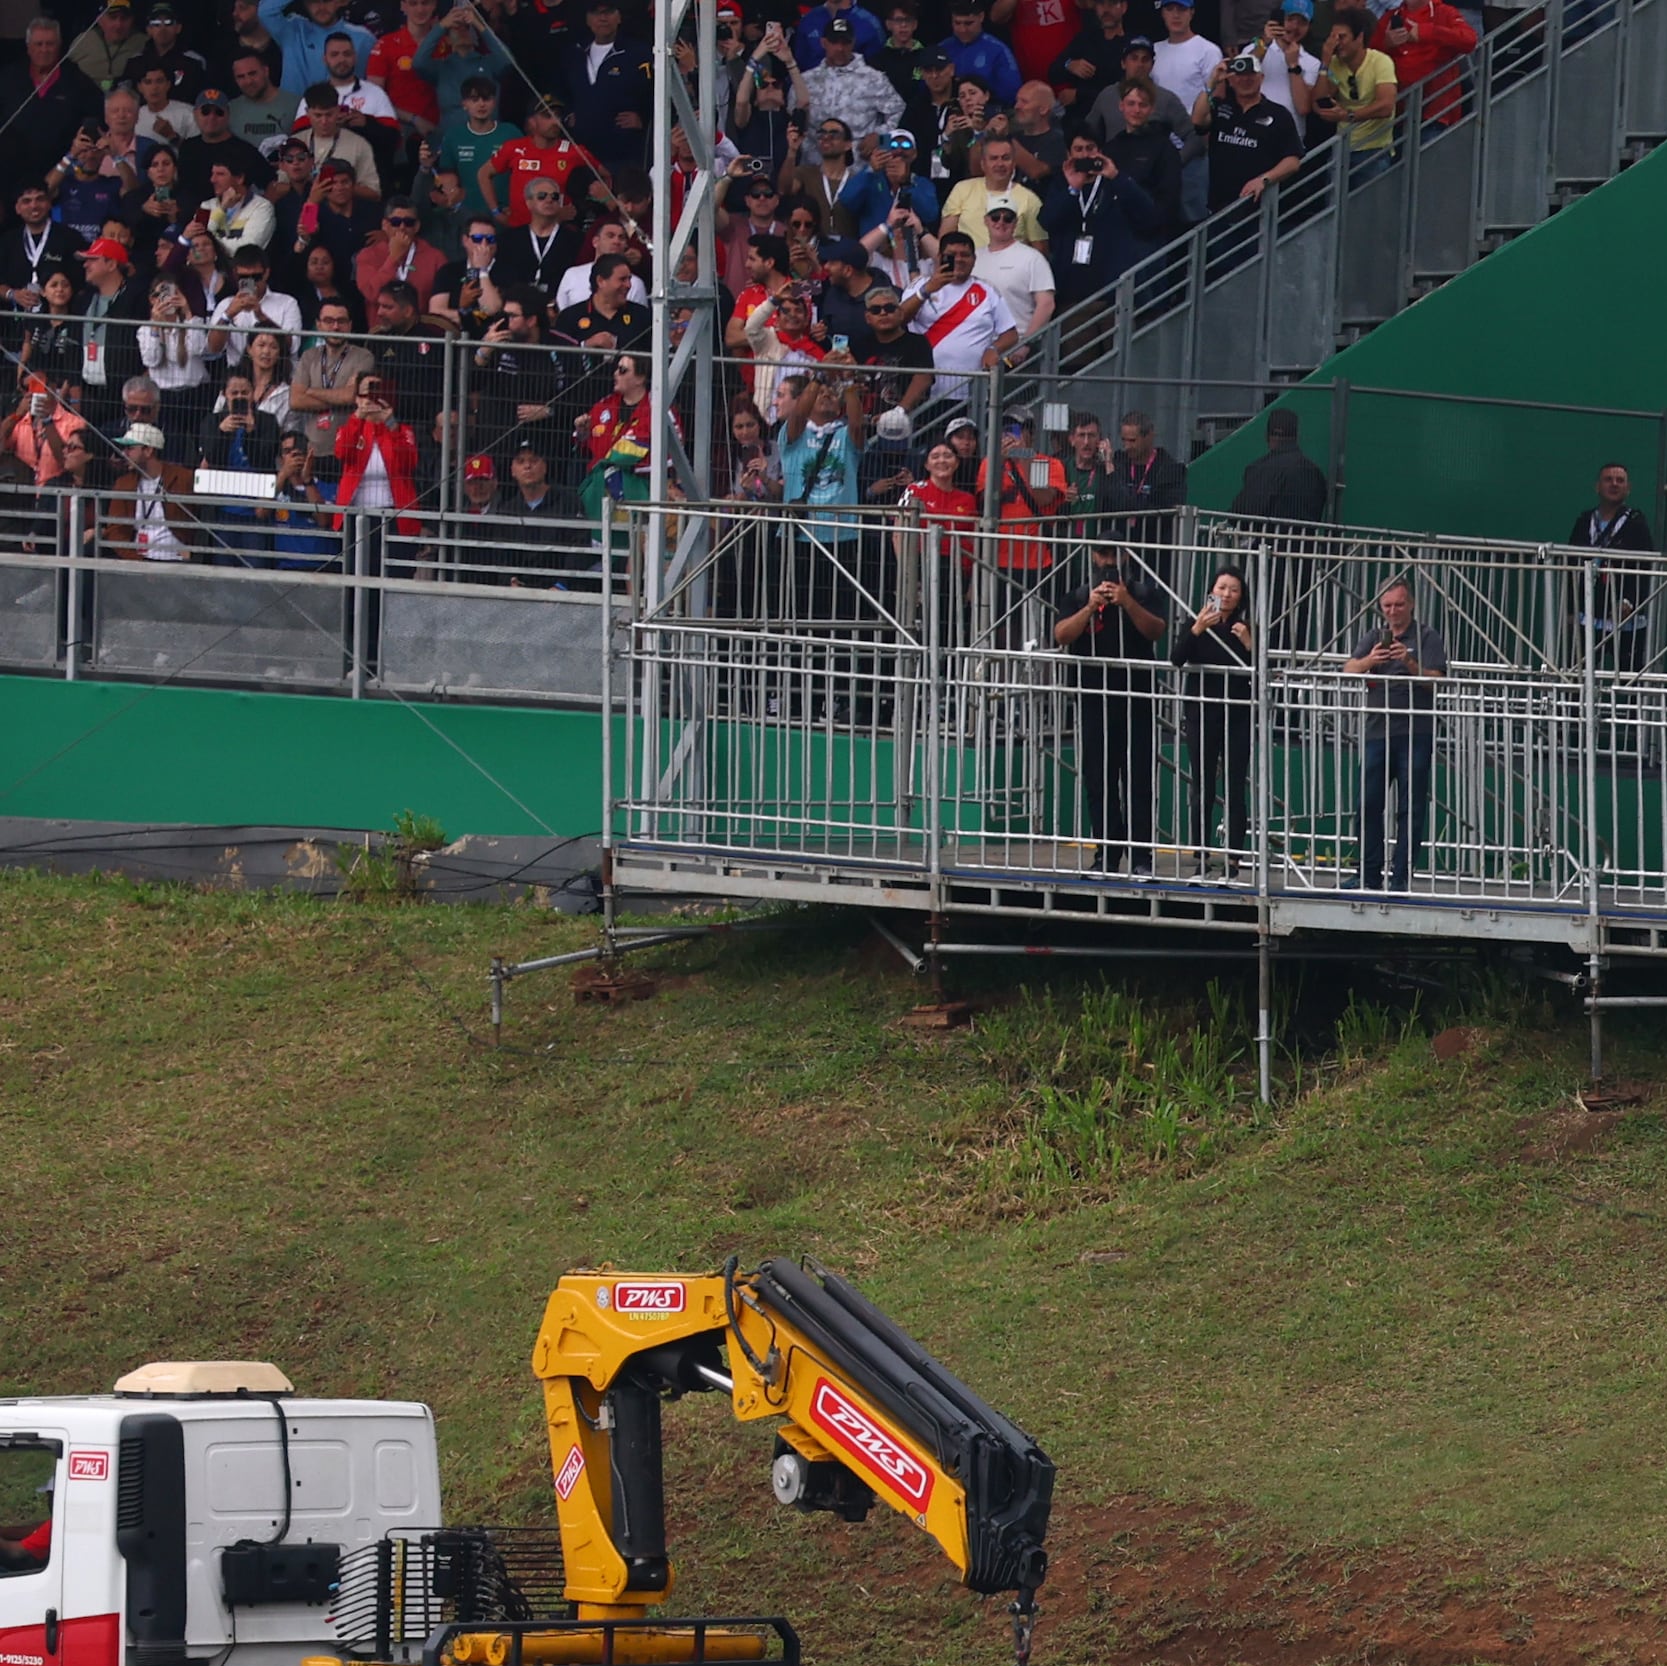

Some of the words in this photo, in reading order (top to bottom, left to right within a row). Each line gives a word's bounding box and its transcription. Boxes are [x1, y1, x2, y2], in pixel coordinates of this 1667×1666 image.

[1218, 131, 1258, 148] Emirates
[625, 1289, 677, 1308] PWS
[830, 1405, 914, 1476] PWS
[73, 1459, 103, 1475] PWS
